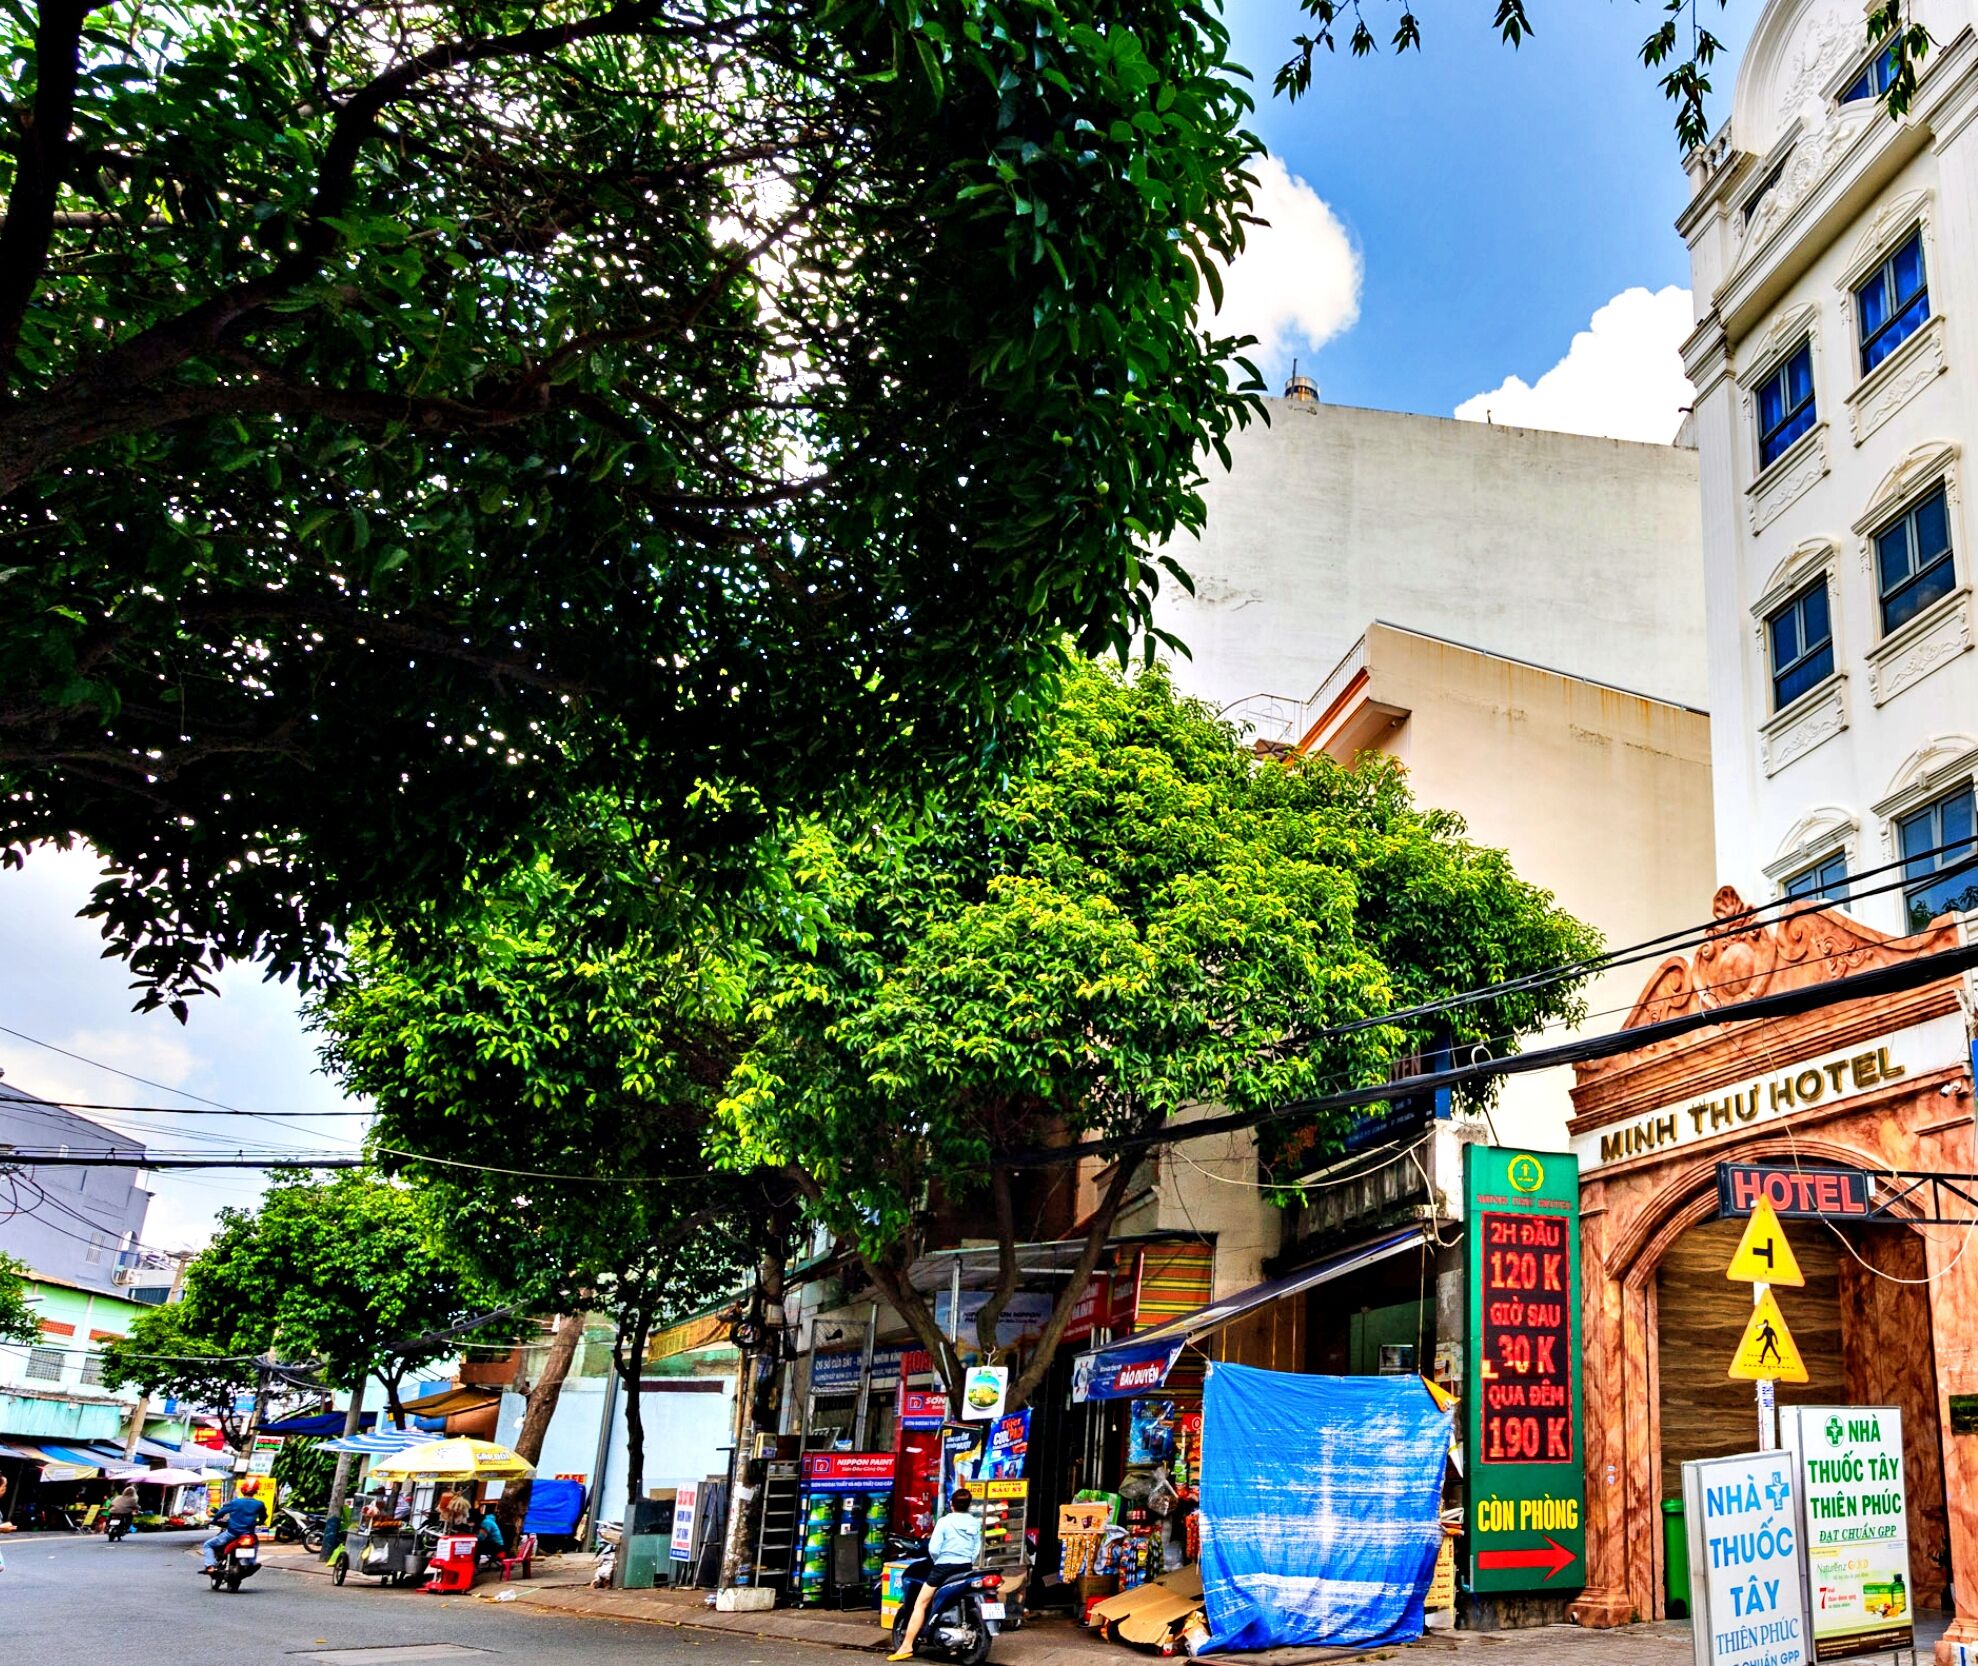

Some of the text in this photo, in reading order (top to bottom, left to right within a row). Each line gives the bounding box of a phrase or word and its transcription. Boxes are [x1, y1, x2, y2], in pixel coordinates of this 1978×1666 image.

[1601, 1047, 1905, 1163] MINH THƯ HOTEL
[1733, 1171, 1865, 1213] HOTEL
[1490, 1222, 1516, 1244] 2H
[1490, 1251, 1562, 1291] 120 K
[1489, 1296, 1561, 1327] GIỜ SAU
[1498, 1334, 1556, 1374] 30 K
[1488, 1379, 1565, 1409] QUA ĐÊM
[1489, 1417, 1567, 1457] 190 K
[1848, 1414, 1881, 1442] NHÀ
[1807, 1450, 1899, 1483] THUỐC TÂY
[1478, 1494, 1578, 1531] CÒN PHÒNG
[1707, 1474, 1762, 1517] NHÀ
[1810, 1488, 1901, 1519] THIÊN PHÚC
[1709, 1516, 1793, 1568] THUỐC
[1878, 1525, 1896, 1537] GPP
[1730, 1574, 1780, 1617] TÂY
[1716, 1625, 1758, 1655] THIÊN
[1760, 1617, 1799, 1645] PHÚC
[1780, 1650, 1800, 1664] GPP
